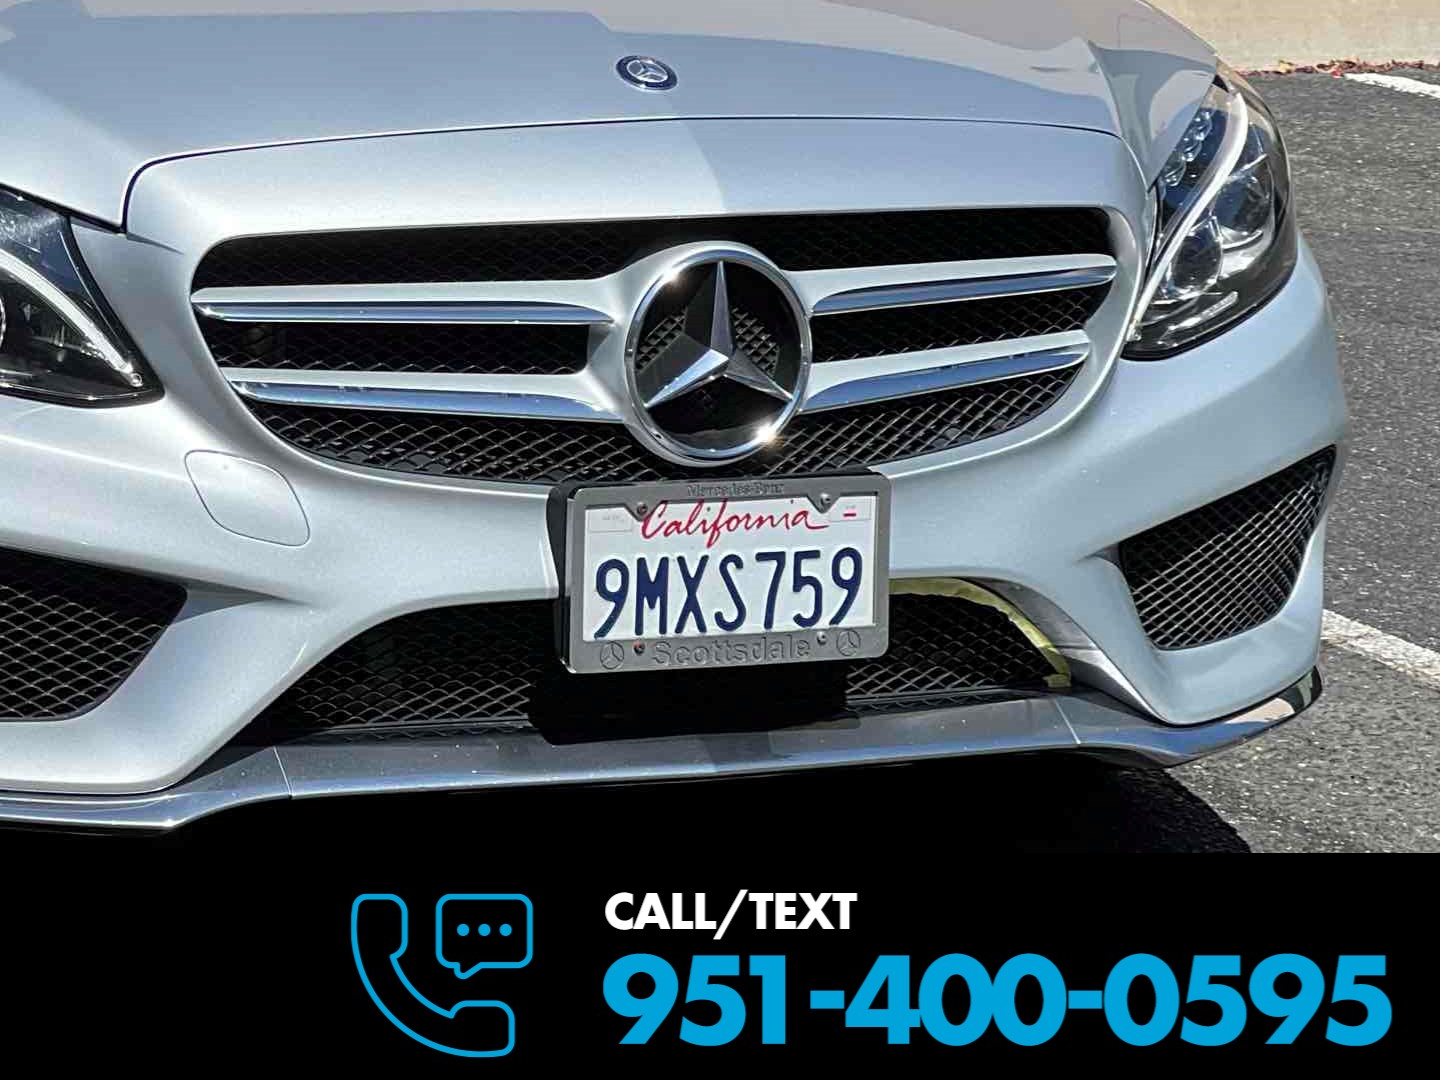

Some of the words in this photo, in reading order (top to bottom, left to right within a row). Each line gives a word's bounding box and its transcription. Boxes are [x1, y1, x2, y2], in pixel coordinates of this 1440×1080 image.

[641, 499, 830, 549] California
[594, 547, 863, 639] 9MXS759
[652, 634, 811, 667] Scottsdale
